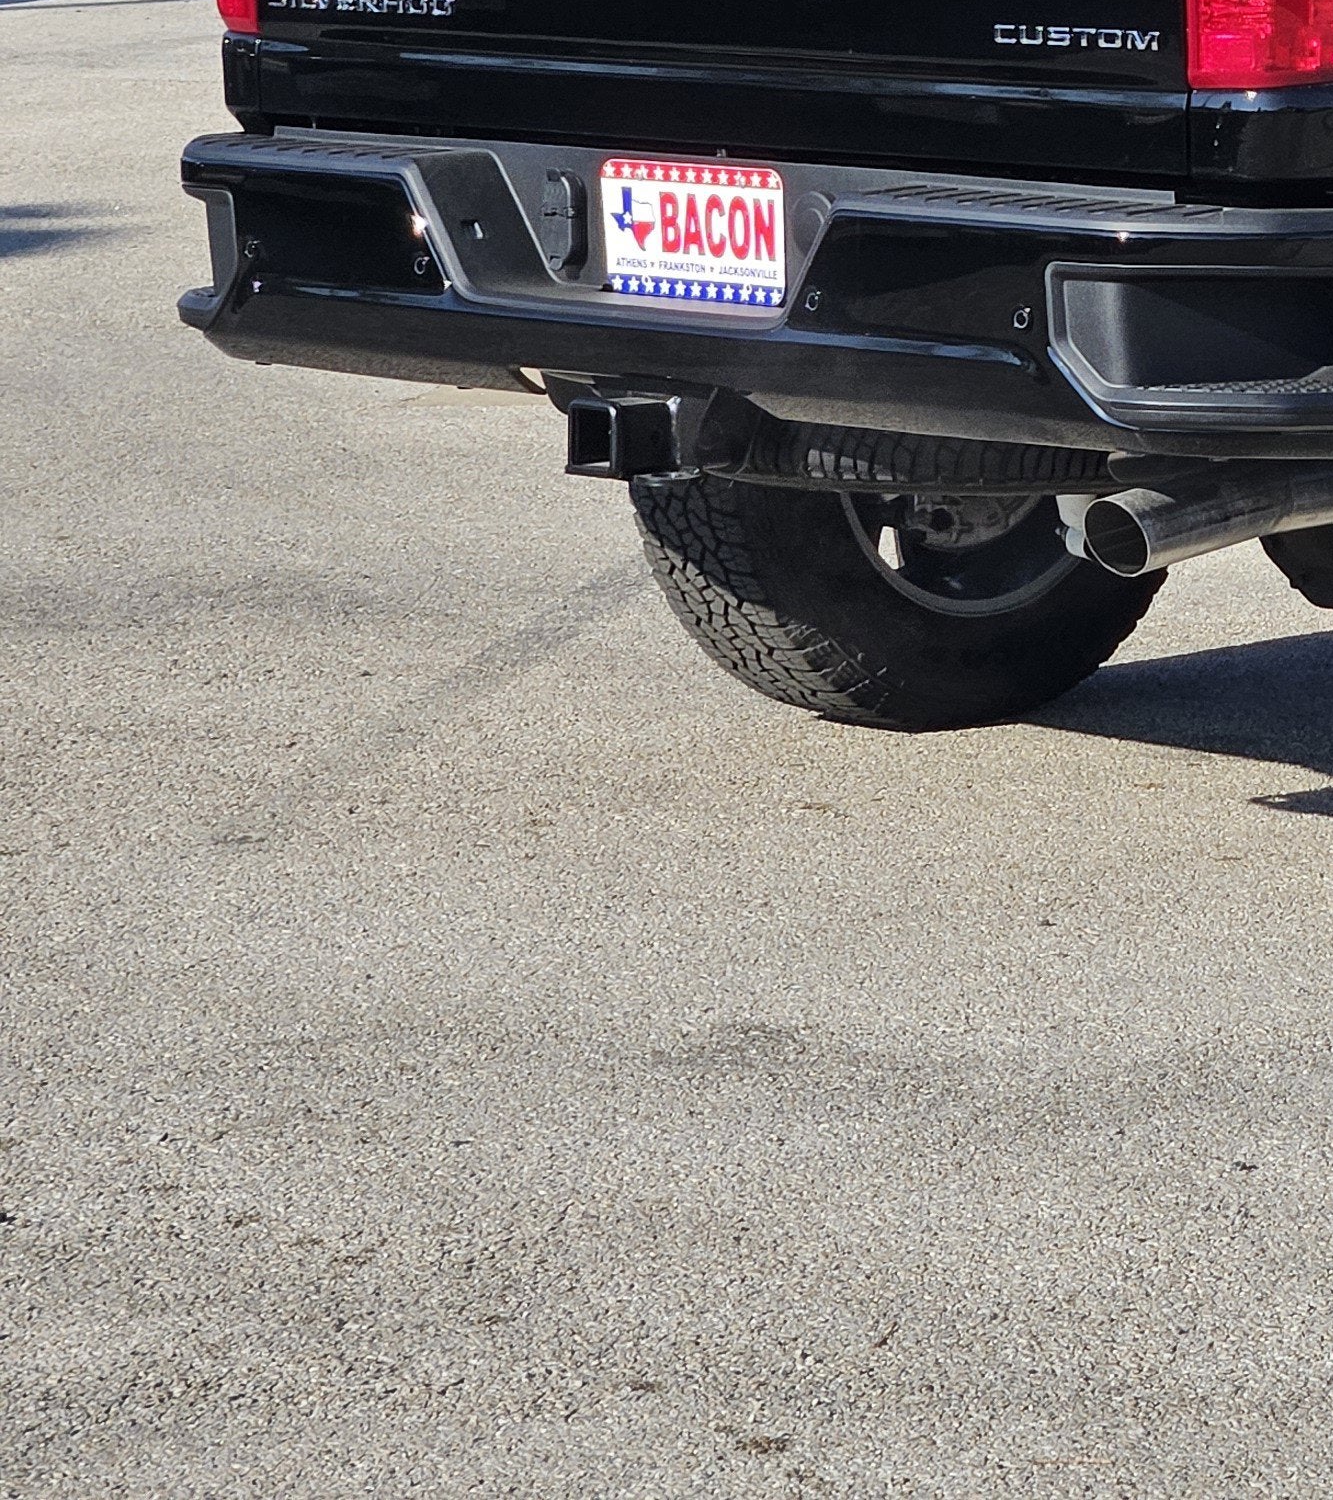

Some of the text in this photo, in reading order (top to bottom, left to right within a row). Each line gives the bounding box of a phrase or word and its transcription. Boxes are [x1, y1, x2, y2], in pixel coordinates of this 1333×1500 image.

[993, 23, 1160, 51] CUSTOM
[659, 191, 777, 262] BACON
[616, 257, 778, 280] ATHENS FRANKSTON JACKSONVILLE
